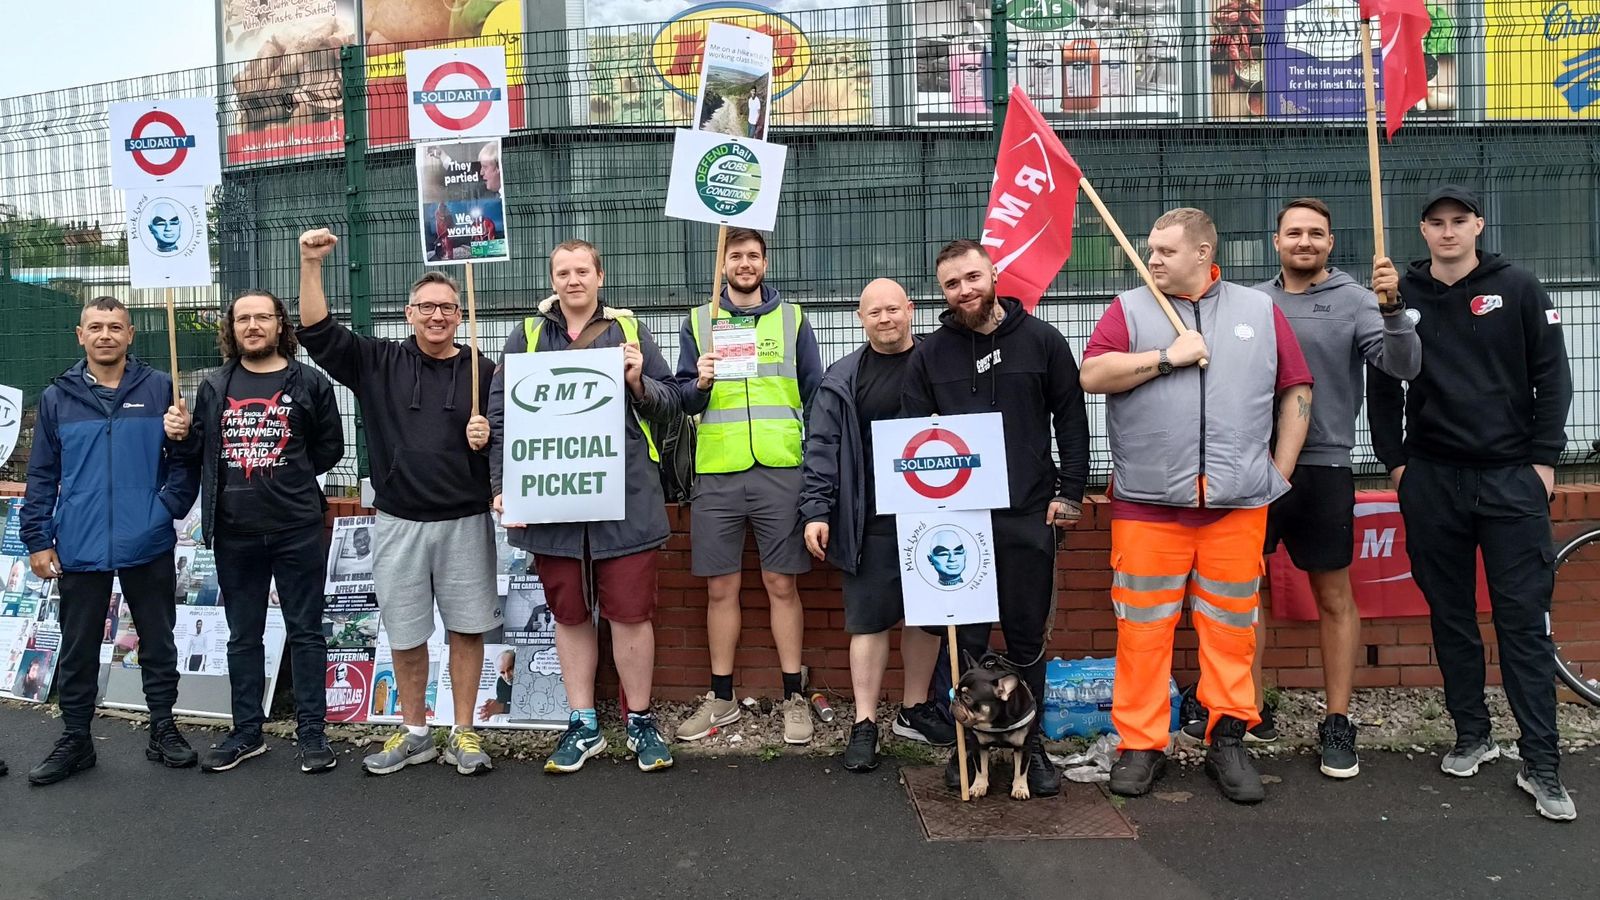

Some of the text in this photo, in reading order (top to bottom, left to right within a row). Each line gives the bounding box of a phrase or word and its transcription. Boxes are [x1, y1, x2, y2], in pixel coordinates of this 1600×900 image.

[244, 4, 271, 16] Served
[270, 11, 293, 25] Taste
[295, 10, 303, 19] to
[304, 1, 337, 17] Satisfy
[708, 51, 735, 63] working
[710, 43, 721, 51] Me
[721, 46, 731, 54] on
[737, 48, 750, 57] hike
[1288, 65, 1305, 75] The
[1306, 65, 1331, 76] finest
[1333, 67, 1353, 77] pure
[1288, 79, 1302, 90] for
[1304, 79, 1318, 90] the
[1320, 79, 1344, 90] finest
[421, 89, 493, 104] SOLIDARITY
[130, 136, 188, 150] SOLIDARITY
[449, 160, 472, 174] They
[697, 144, 752, 182] DEFEND Rail
[721, 160, 749, 172] JOBS
[444, 171, 480, 187] partied
[715, 173, 737, 184] PAY
[705, 185, 752, 200] CONDITIONS
[719, 203, 735, 211] RMT
[455, 212, 471, 224] We
[131, 216, 139, 241] Mick
[447, 224, 483, 236] worked
[532, 380, 599, 403] RMT
[223, 409, 243, 417] OPLE
[267, 405, 293, 417] NOT
[226, 417, 257, 427] AFRAID
[265, 419, 288, 428] THEIR
[220, 447, 284, 460] BE AFRAID OF
[511, 434, 618, 462] OFFICIAL
[245, 456, 288, 468] PEOPLE.
[901, 455, 973, 471] SOLIDARITY
[521, 471, 607, 498] PICKET
[975, 531, 987, 548] Man
[903, 521, 928, 573] Mick Lynch
[510, 582, 521, 590] THE
[968, 570, 990, 592] People
[335, 584, 358, 594] AFFECT
[327, 652, 370, 662] OFITEERING
[346, 688, 363, 705] CLASS
